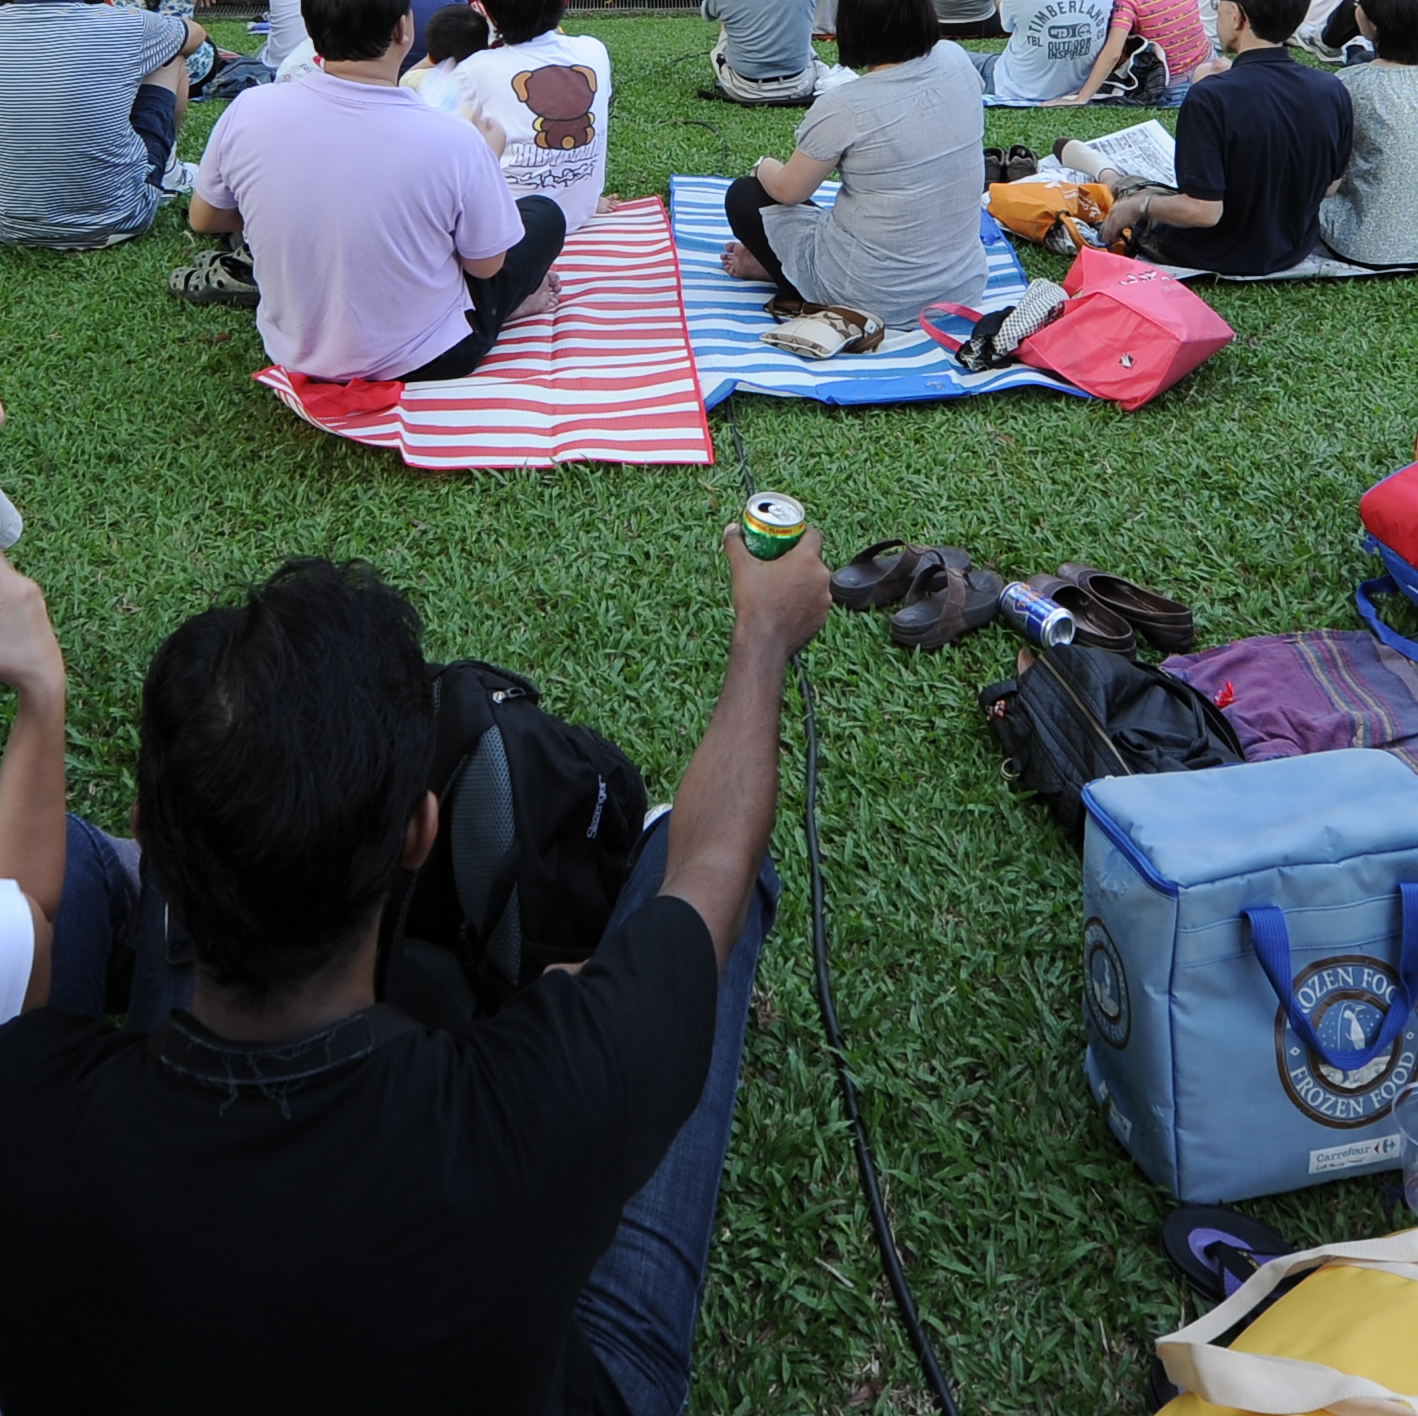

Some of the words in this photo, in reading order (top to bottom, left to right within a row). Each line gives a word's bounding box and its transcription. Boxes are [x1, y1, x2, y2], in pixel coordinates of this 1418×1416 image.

[1028, 0, 1105, 34] TIMBERLAND
[1047, 37, 1093, 51] OUTDOOR
[1297, 966, 1355, 1014] OZEN
[1361, 968, 1401, 1006] FOO
[1290, 1066, 1364, 1118] FROZEN
[1369, 1051, 1415, 1109] FOOD
[1316, 1146, 1371, 1163] Carrefour
